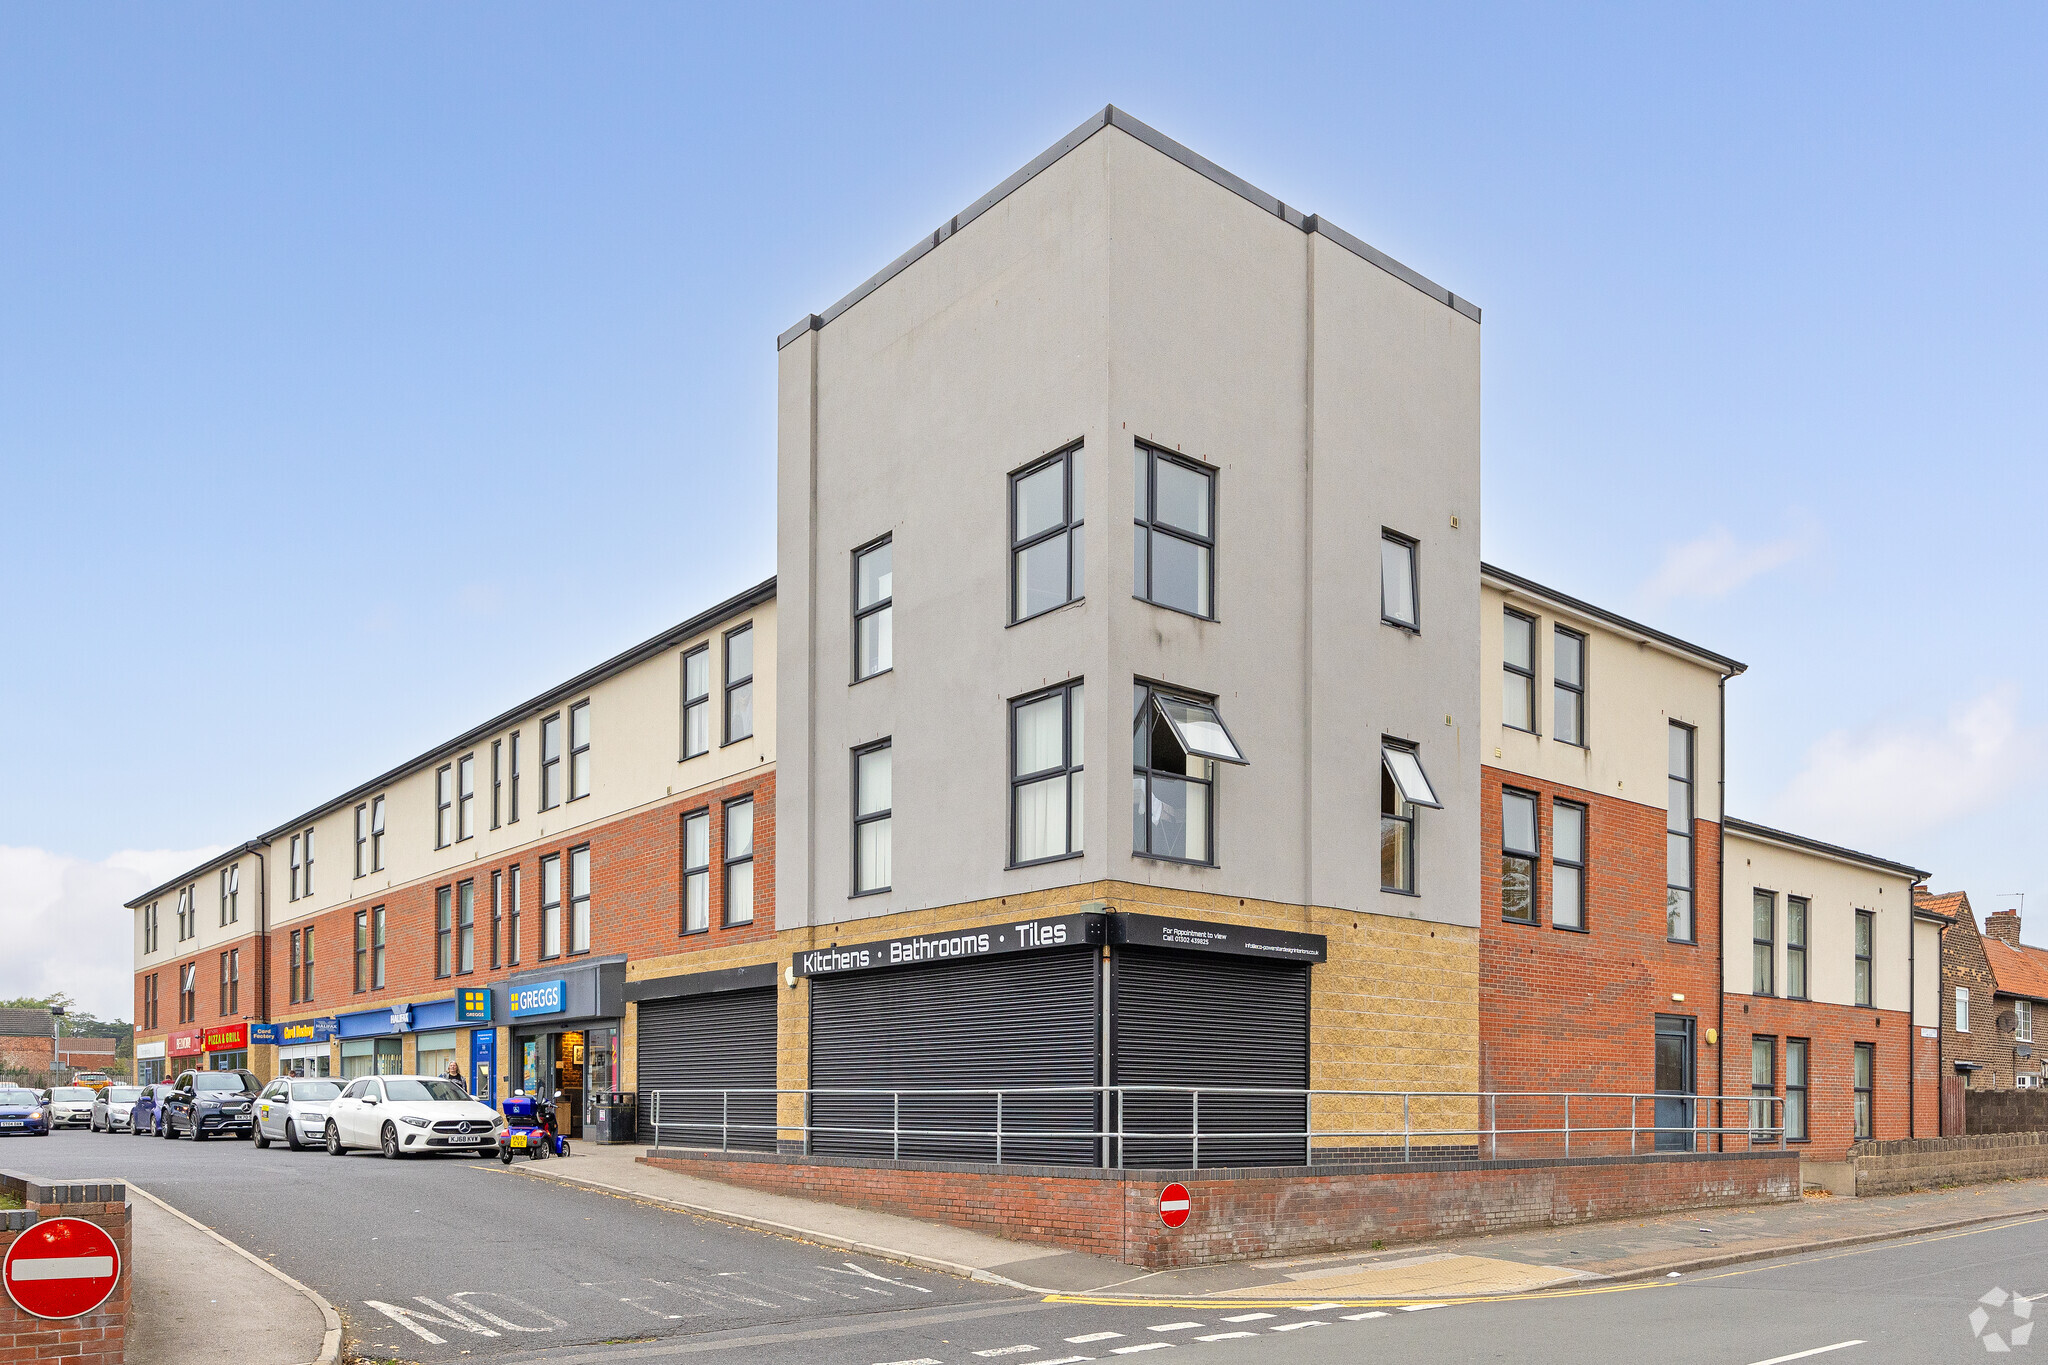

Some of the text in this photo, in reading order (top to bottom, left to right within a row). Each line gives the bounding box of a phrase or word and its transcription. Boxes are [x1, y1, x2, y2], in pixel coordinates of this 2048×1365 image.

[1162, 934, 1174, 942] Call
[1174, 936, 1190, 944] 01302
[1173, 928, 1207, 938] Appointment
[803, 922, 1067, 973] Kitchens Bathrooms Tiles
[520, 986, 559, 1010] GREGGS
[390, 1012, 409, 1024] HALIFAX
[207, 1034, 221, 1046] PIZZA
[225, 1031, 241, 1044] GRILL
[284, 1024, 315, 1040] Card Factory
